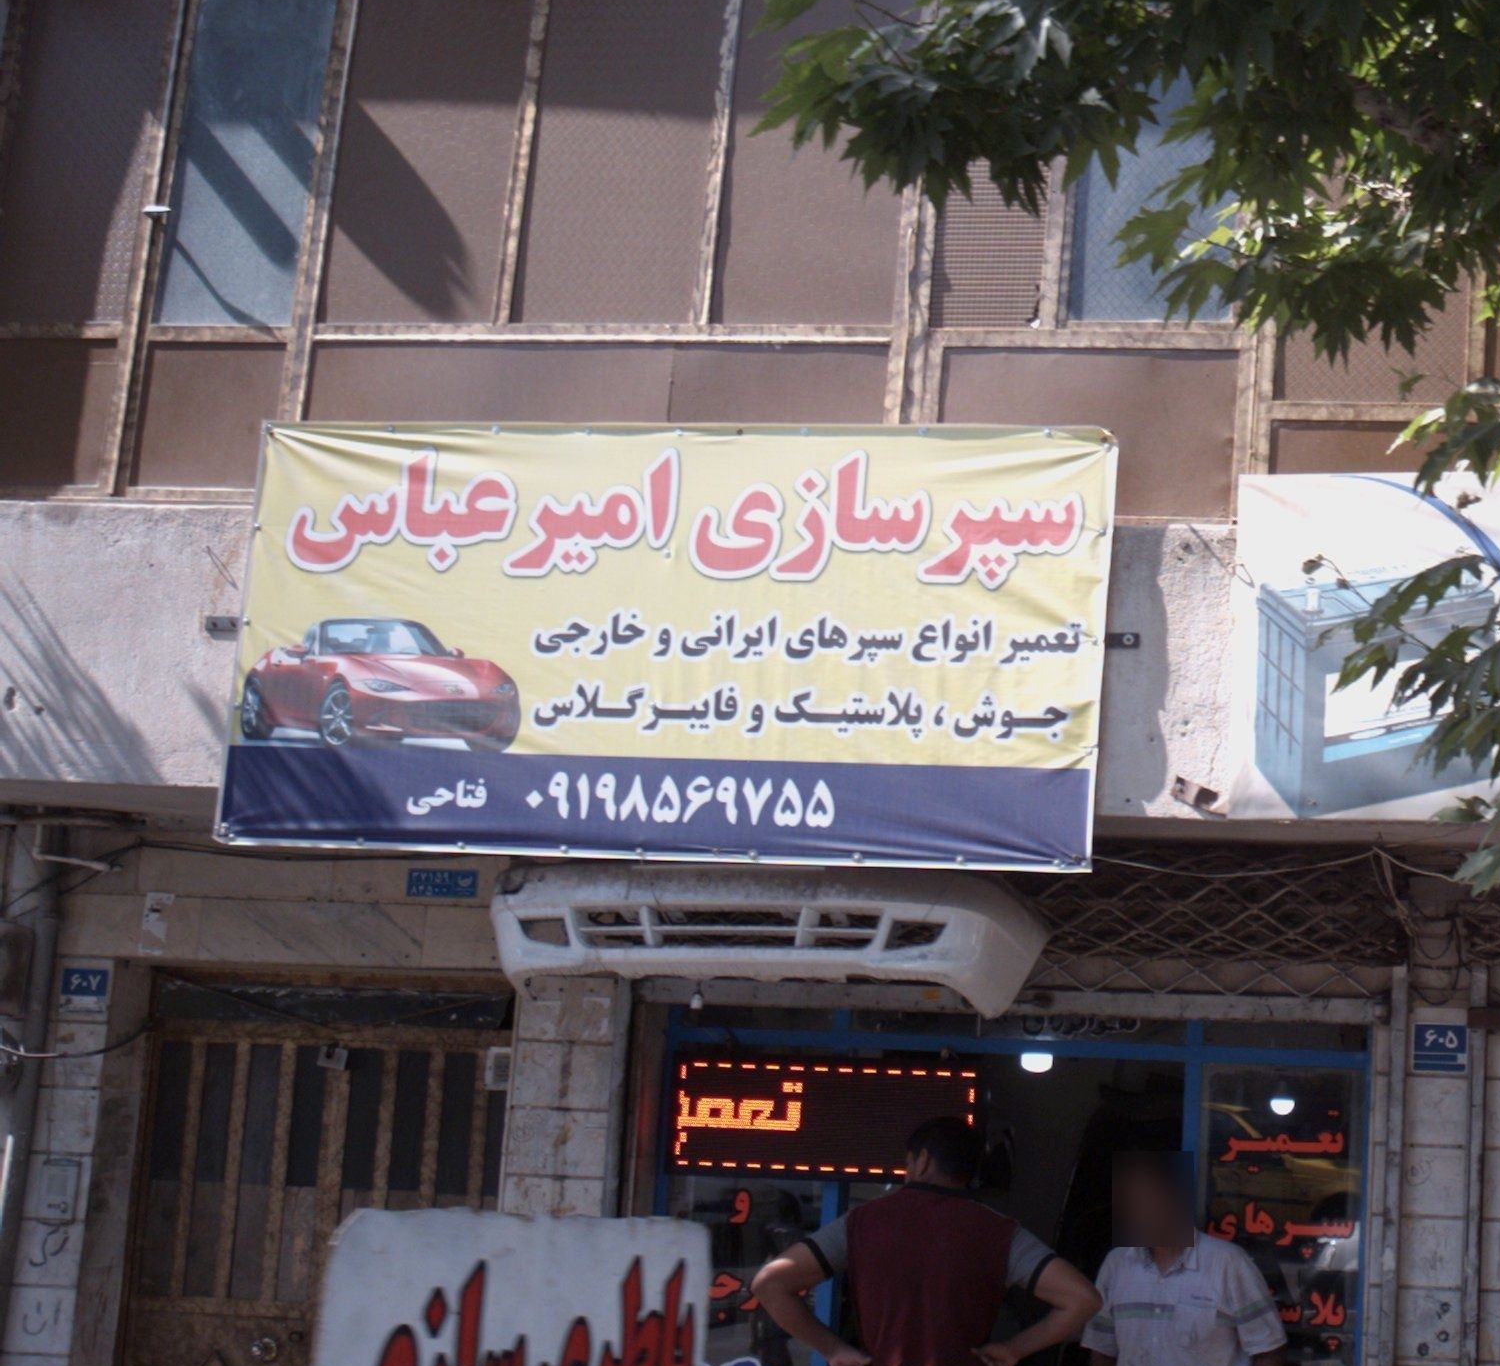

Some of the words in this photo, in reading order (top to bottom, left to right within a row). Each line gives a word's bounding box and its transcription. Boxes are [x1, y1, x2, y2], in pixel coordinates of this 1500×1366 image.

[534, 612, 647, 656] خارجی
[653, 627, 672, 657] و
[680, 614, 778, 659] ایرانی
[911, 618, 993, 663] انواع
[999, 622, 1081, 665] تعمیر
[745, 702, 765, 734] و
[774, 690, 923, 739] پلاستیک
[406, 777, 488, 815] فتاحی
[525, 771, 836, 828] ۰۹۱۹۸۵۶۹۷۵۵
[70, 974, 101, 991] ۶۰۷
[1424, 1029, 1458, 1049] ۶۰۵
[1218, 1109, 1345, 1175] تعمیر
